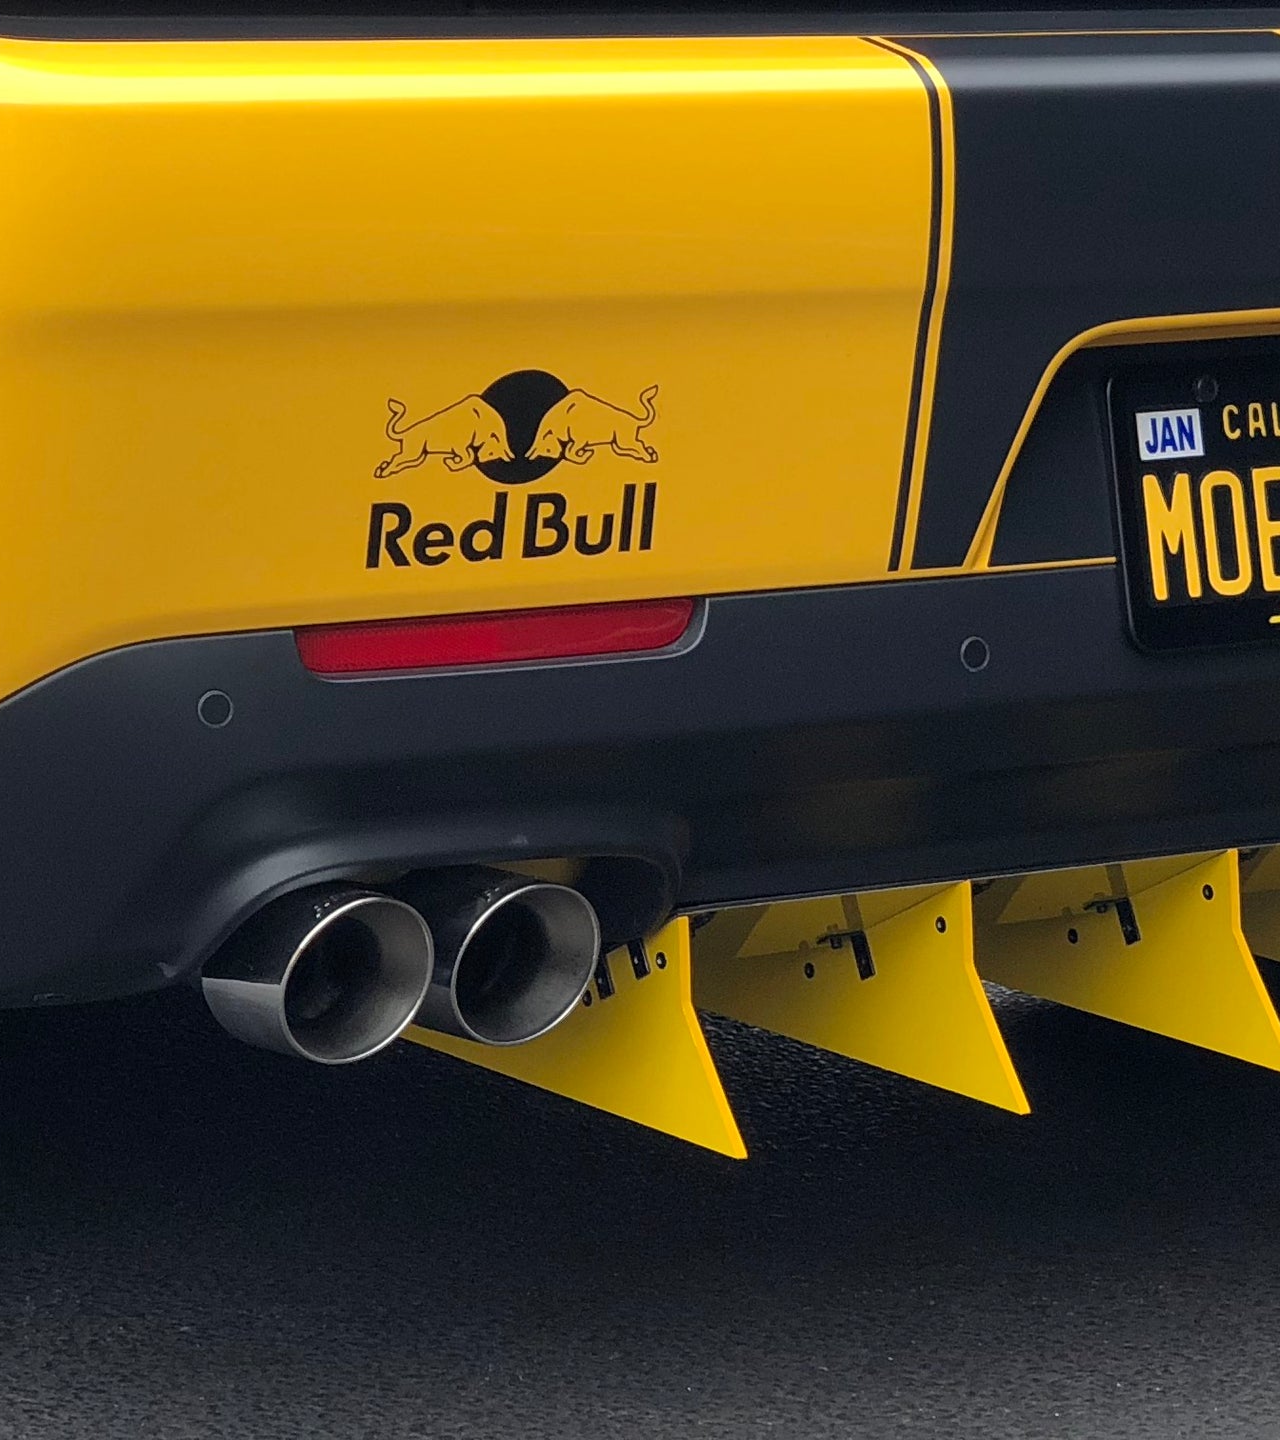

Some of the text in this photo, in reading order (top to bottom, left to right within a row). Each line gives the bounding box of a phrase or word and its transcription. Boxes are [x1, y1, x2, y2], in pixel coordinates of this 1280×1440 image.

[1145, 414, 1197, 455] JAN
[365, 482, 657, 569] Red Bull
